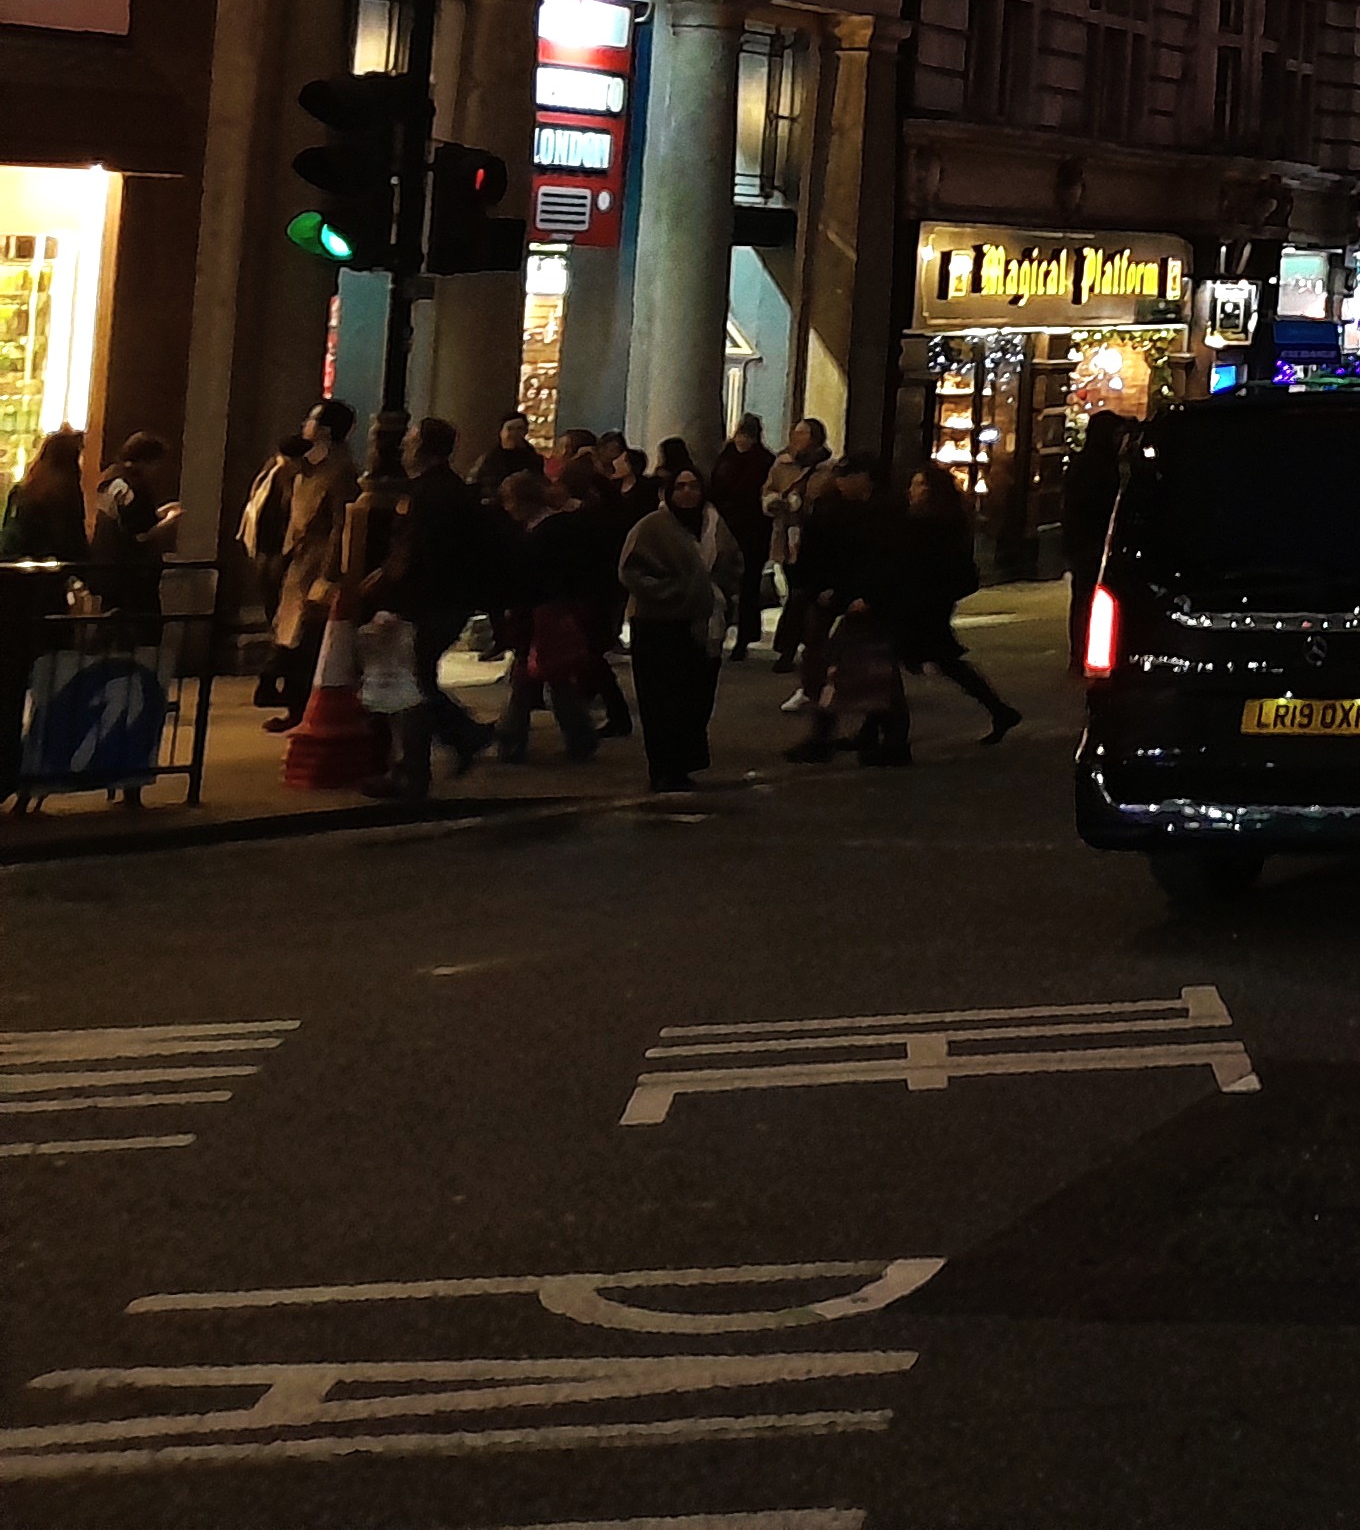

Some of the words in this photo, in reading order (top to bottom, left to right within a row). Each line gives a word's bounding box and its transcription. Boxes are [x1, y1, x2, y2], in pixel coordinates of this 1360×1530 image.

[533, 127, 612, 169] LONDON
[981, 244, 1067, 307] Magical
[1081, 247, 1159, 306] Platform
[1255, 702, 1314, 730] LR19
